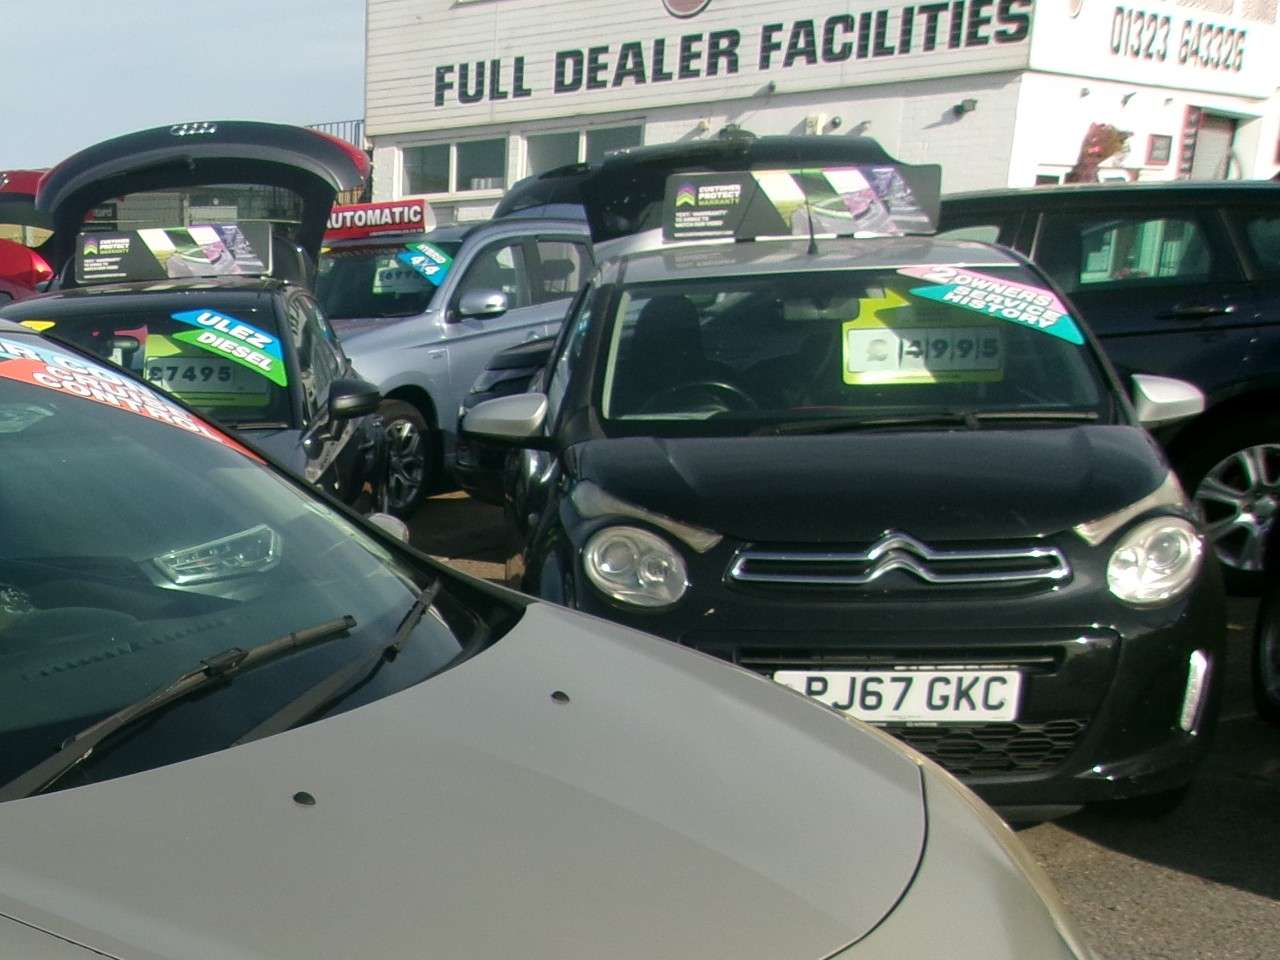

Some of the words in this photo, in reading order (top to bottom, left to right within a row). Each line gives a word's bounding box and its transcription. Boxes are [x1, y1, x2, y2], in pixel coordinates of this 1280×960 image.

[434, 56, 532, 107] FULL
[554, 28, 740, 94] DEALER
[759, 0, 1031, 70] FACILITIES
[1109, 6, 1171, 62] 01323
[1177, 19, 1247, 72] 643326
[923, 266, 958, 284] 2
[956, 273, 1054, 307] OWNERS
[953, 285, 1061, 322] SERVICE
[943, 293, 1056, 328] HISTORY
[196, 312, 273, 348] ULEZ
[196, 332, 273, 371] DIESEL
[866, 338, 1000, 362] £4995
[150, 366, 232, 382] £7495
[33, 372, 223, 443] CONTROL
[805, 676, 914, 712] PJ67
[926, 676, 1008, 711] GKC
